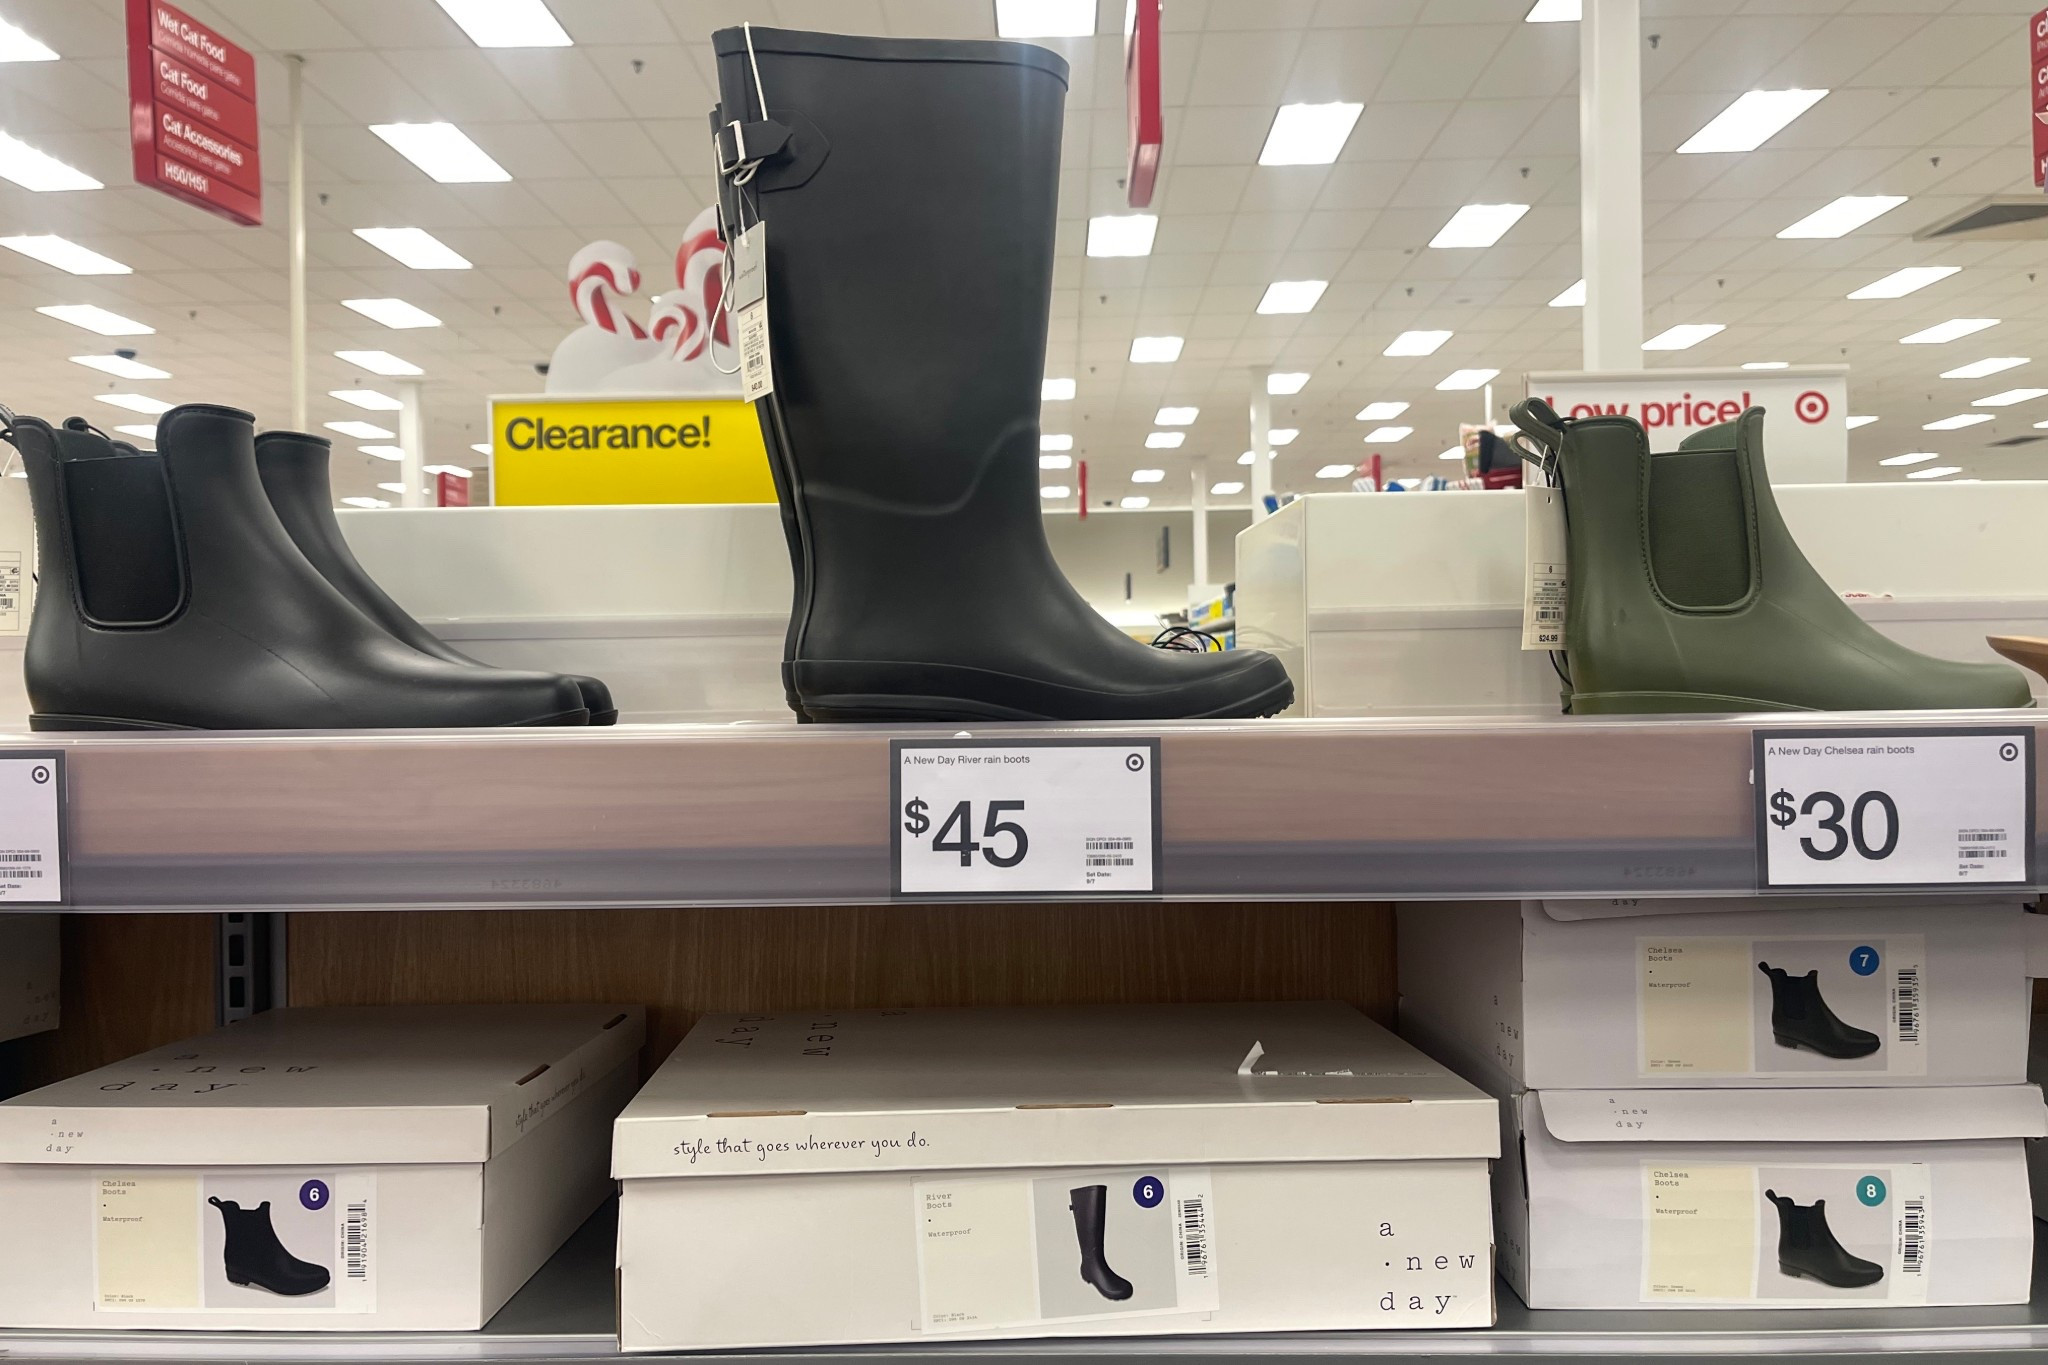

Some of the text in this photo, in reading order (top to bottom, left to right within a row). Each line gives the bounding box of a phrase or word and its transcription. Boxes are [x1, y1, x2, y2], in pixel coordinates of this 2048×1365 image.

[157, 8, 226, 63] Wet Cat Food
[160, 61, 208, 100] Cat Food
[162, 112, 243, 167] Cat Accessories
[505, 414, 711, 451] Clearance!
[1539, 634, 1558, 642] $24.99
[1768, 745, 1915, 758] A New Day Chelsea rain boots
[904, 754, 1030, 767] A New Day River rain boots
[1860, 954, 1869, 967] 7
[184, 1065, 318, 1075] new
[100, 1081, 238, 1094] day
[1621, 1108, 1648, 1116] new
[1615, 1120, 1644, 1129] day
[46, 1144, 72, 1154] day
[673, 1131, 931, 1164] style that goes wherever you do.
[1653, 1171, 1689, 1179] Chelsea
[309, 1188, 320, 1202] 6
[926, 1193, 952, 1201] River
[1143, 1185, 1154, 1199] 6
[1866, 1184, 1877, 1198] 8
[926, 1202, 952, 1210] Boots
[928, 1228, 972, 1238] Waterproof
[1380, 1222, 1394, 1236] a
[1199, 1239, 1208, 1266] 96761
[1406, 1254, 1475, 1270] new
[1380, 1292, 1452, 1315] day
